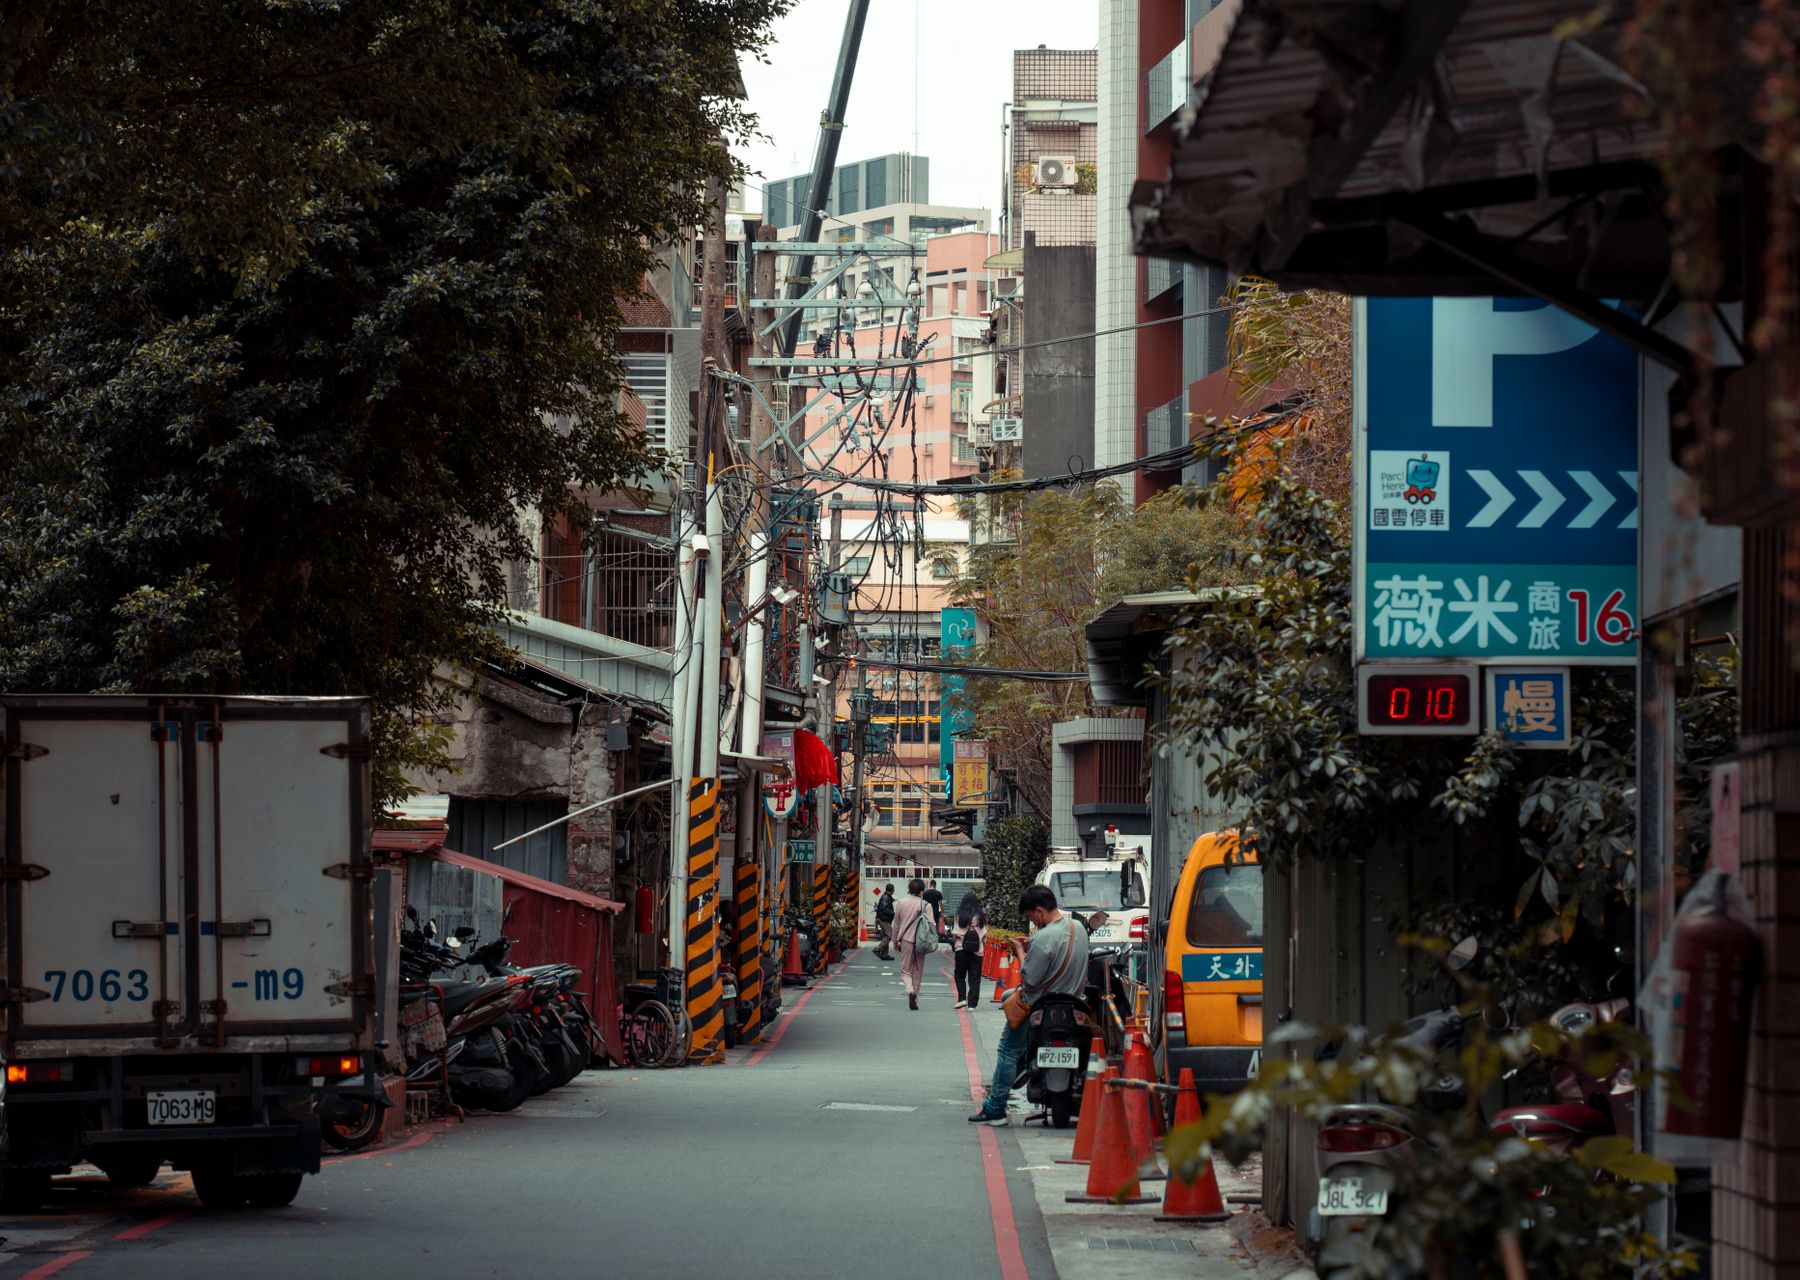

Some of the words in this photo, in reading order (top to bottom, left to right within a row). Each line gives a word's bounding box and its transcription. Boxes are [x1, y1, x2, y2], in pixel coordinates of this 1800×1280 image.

[1432, 296, 1620, 427] P
[1382, 482, 1406, 491] Here
[1373, 507, 1445, 527] 國雲停車
[1373, 573, 1518, 650] 薇米
[1527, 580, 1561, 651] 商旅
[1566, 588, 1635, 646] 16
[1502, 679, 1557, 733] 慢
[1206, 954, 1263, 981] 天外
[44, 968, 150, 1002] 7063
